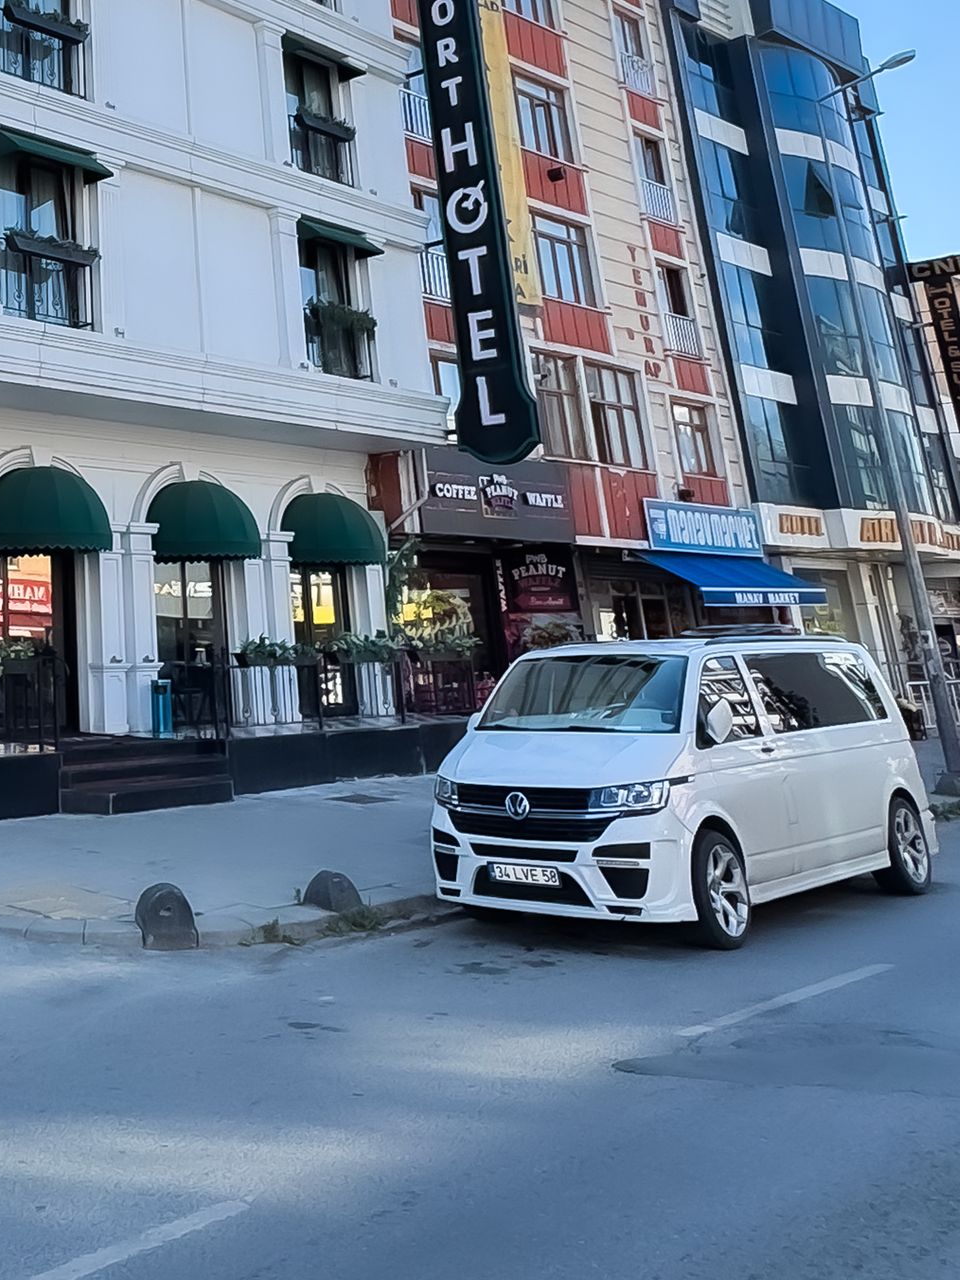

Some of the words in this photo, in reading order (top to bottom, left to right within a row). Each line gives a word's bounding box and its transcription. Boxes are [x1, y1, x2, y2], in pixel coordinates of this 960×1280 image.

[441, 121, 507, 427] HOTEL
[911, 258, 960, 279] CN
[434, 483, 478, 500] COFFEE
[485, 484, 519, 501] PEANUT
[525, 491, 565, 509] WAFFLE
[511, 563, 566, 580] PEANUT
[767, 592, 800, 604] MARKET
[496, 866, 510, 878] 34
[513, 868, 539, 882] LVE
[542, 870, 558, 884] 58
